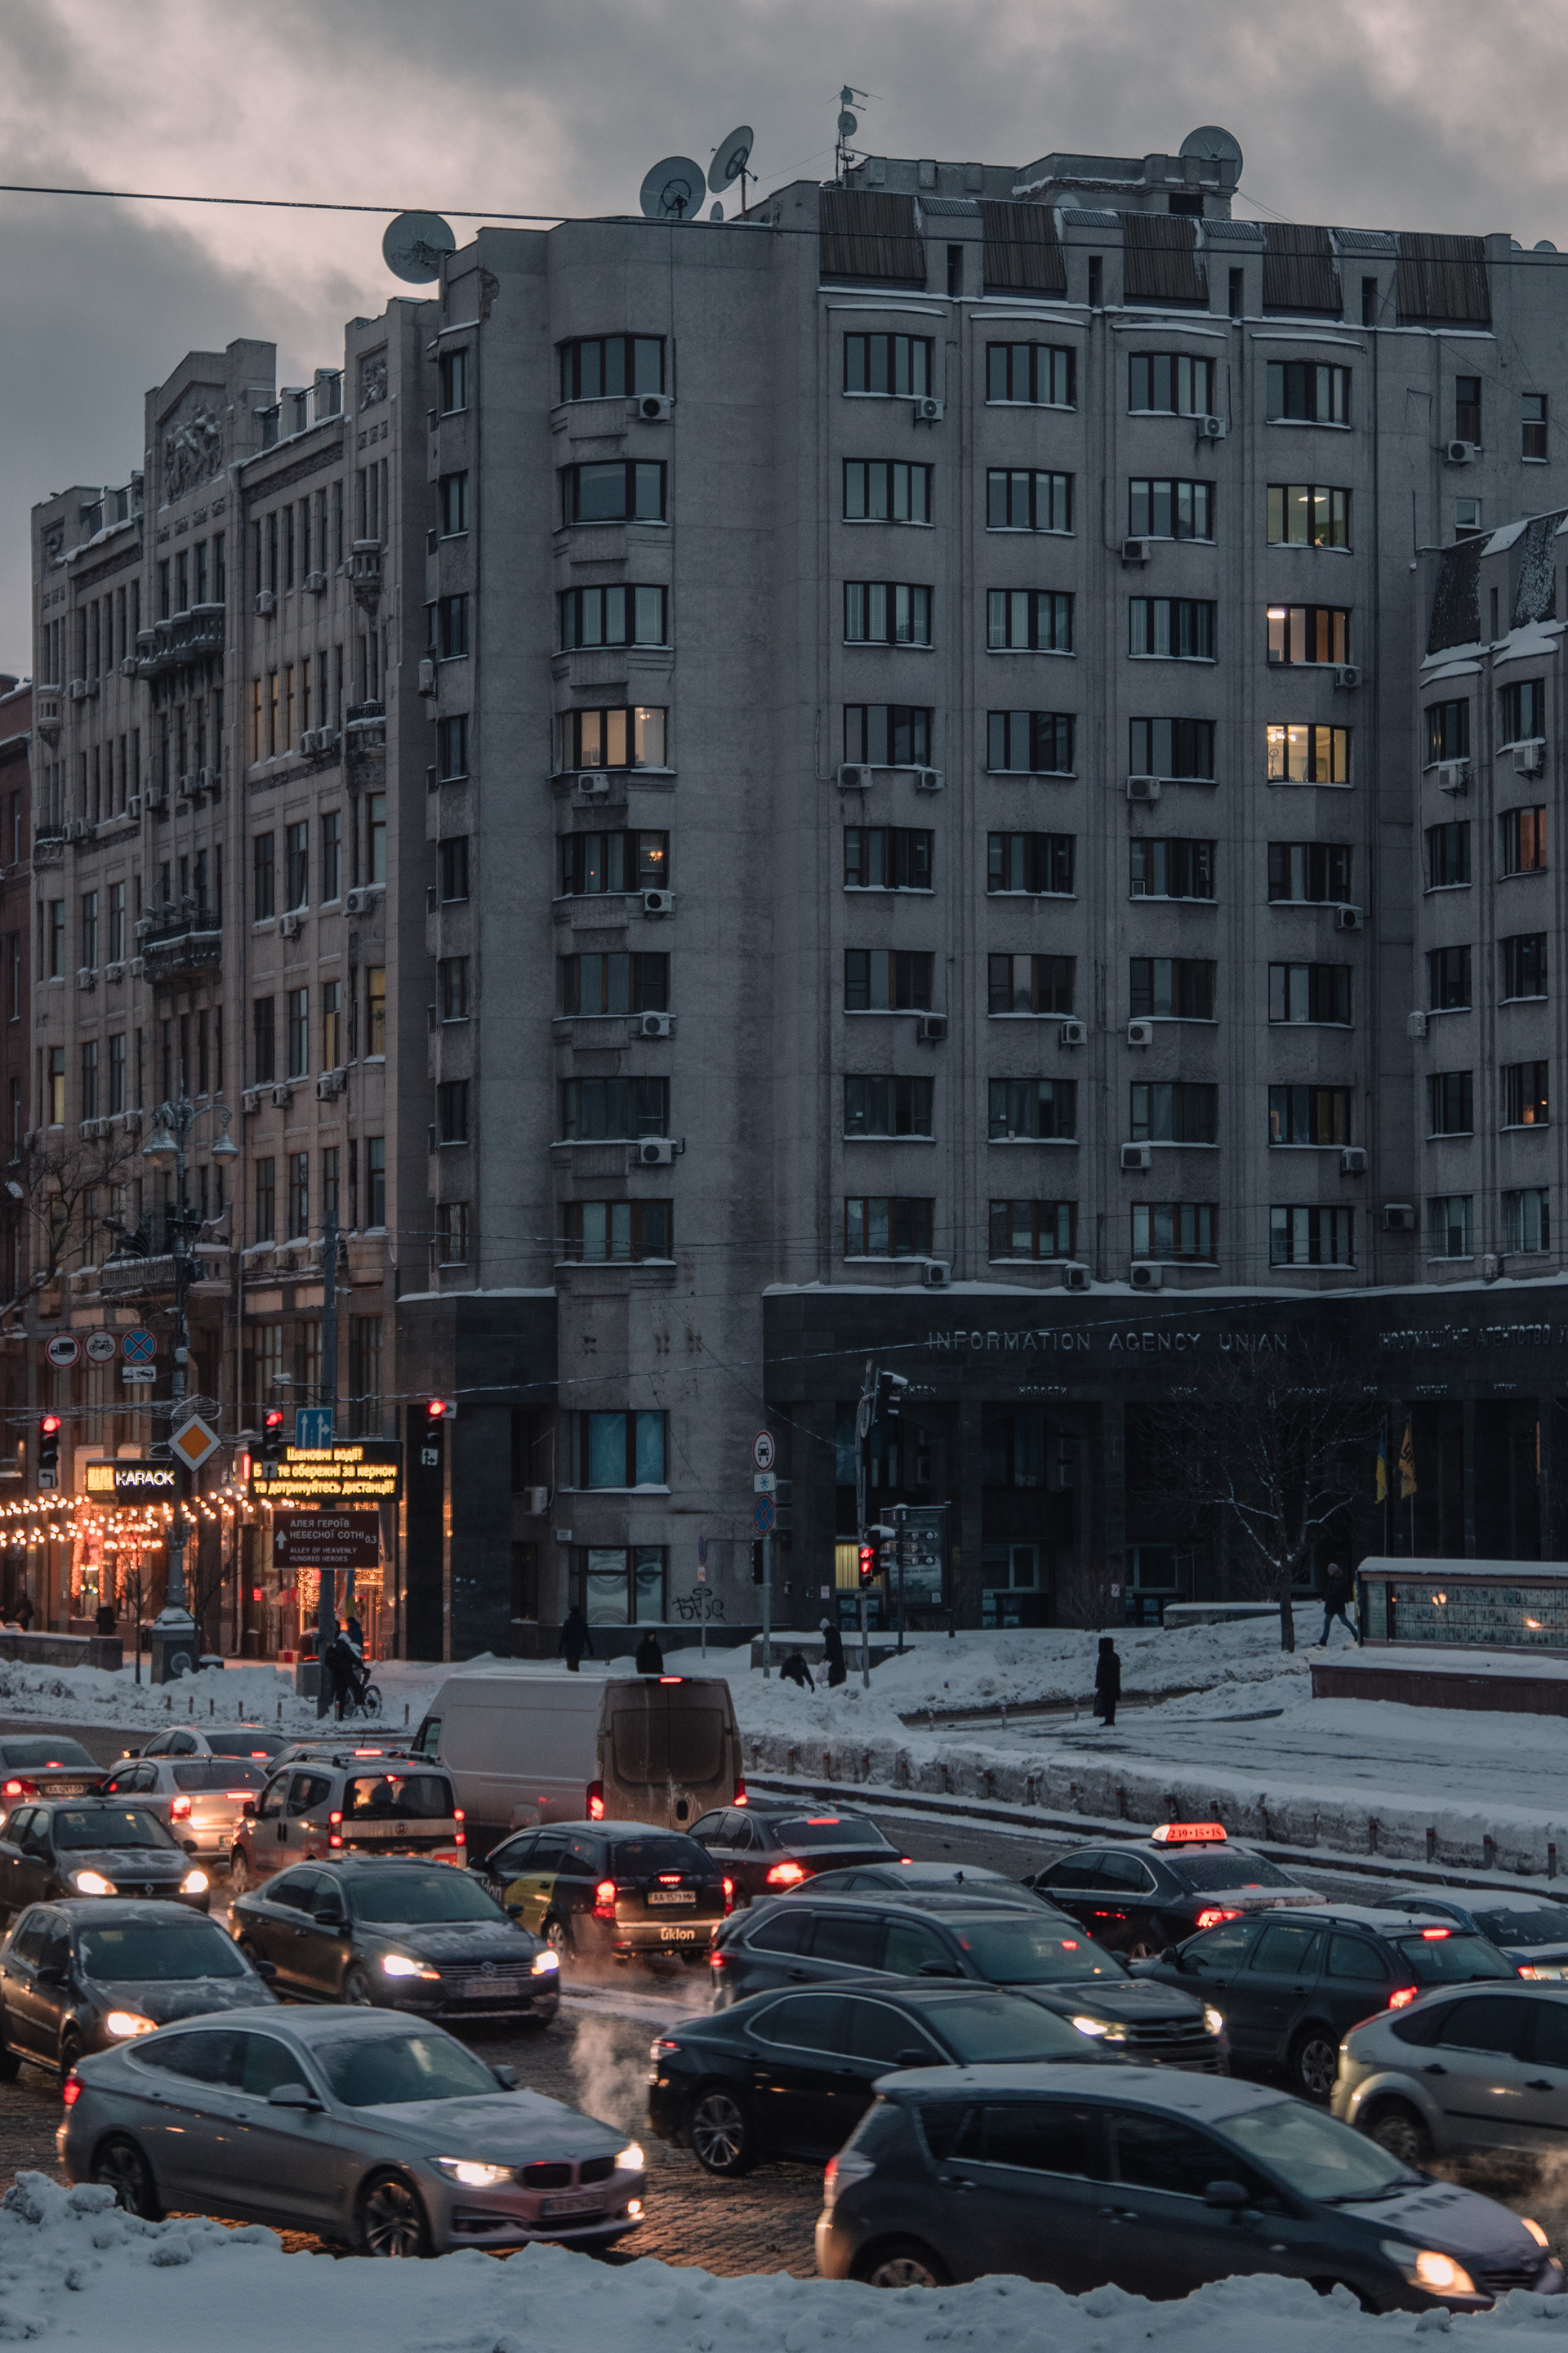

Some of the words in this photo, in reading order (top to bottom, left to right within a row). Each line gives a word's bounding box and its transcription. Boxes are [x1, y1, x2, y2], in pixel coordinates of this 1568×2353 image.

[929, 1330, 1090, 1351] INFORMATION
[1108, 1332, 1201, 1352] AGENCY
[1218, 1334, 1288, 1352] UNIAN
[1018, 1386, 1067, 1396] НОВОСТИ
[287, 1446, 332, 1461] Шановні
[333, 1446, 363, 1462] водії!
[115, 1469, 176, 1486] KARAOK
[253, 1462, 291, 1477] Бте
[292, 1462, 341, 1479] обережні
[342, 1464, 356, 1477] за
[357, 1464, 398, 1479] кермом
[254, 1481, 267, 1494] та
[268, 1478, 341, 1496] дотримуйтесь
[342, 1479, 395, 1495] дистанції!
[290, 1520, 314, 1528] АЛЕЯ
[317, 1518, 350, 1528] ГЕРОЇВ
[289, 1530, 335, 1540] НЕБЕСНОЇ
[337, 1531, 364, 1540] СОТНІ
[364, 1535, 377, 1544] 0,3
